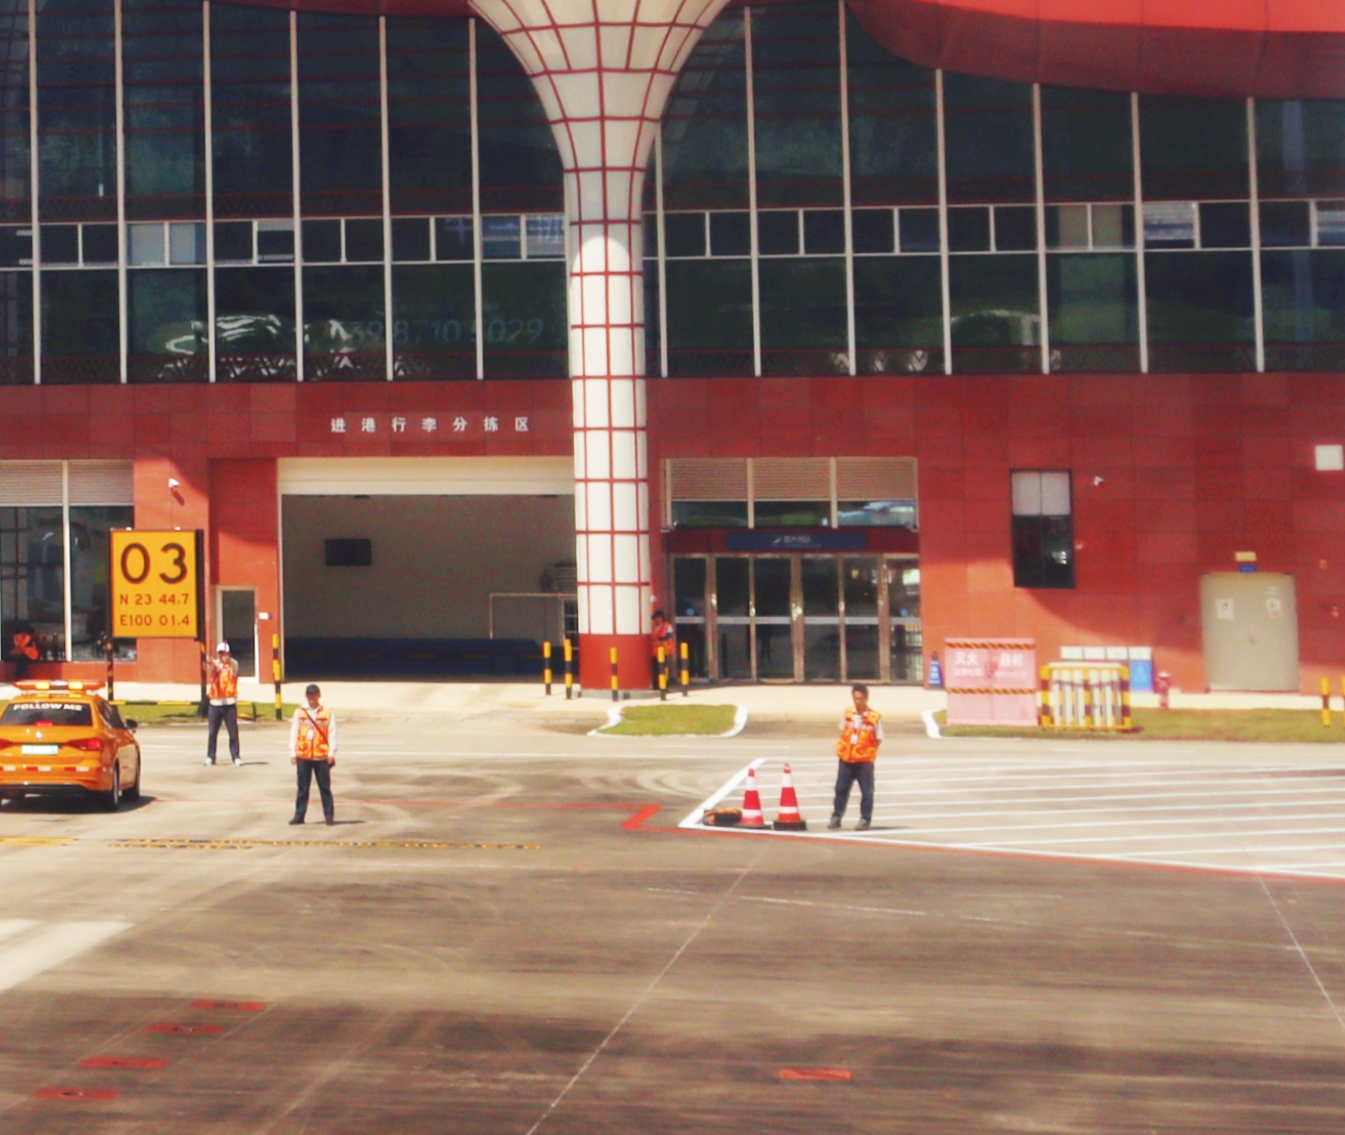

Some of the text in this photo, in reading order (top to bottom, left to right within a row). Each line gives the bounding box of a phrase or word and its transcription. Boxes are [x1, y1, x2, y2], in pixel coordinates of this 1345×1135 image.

[330, 416, 530, 433] 进港行李分拣区
[120, 542, 188, 585] 03
[120, 593, 189, 605] N 23 44.7
[120, 614, 189, 626] E100 01.4
[13, 702, 84, 712] FOLLOW ME
